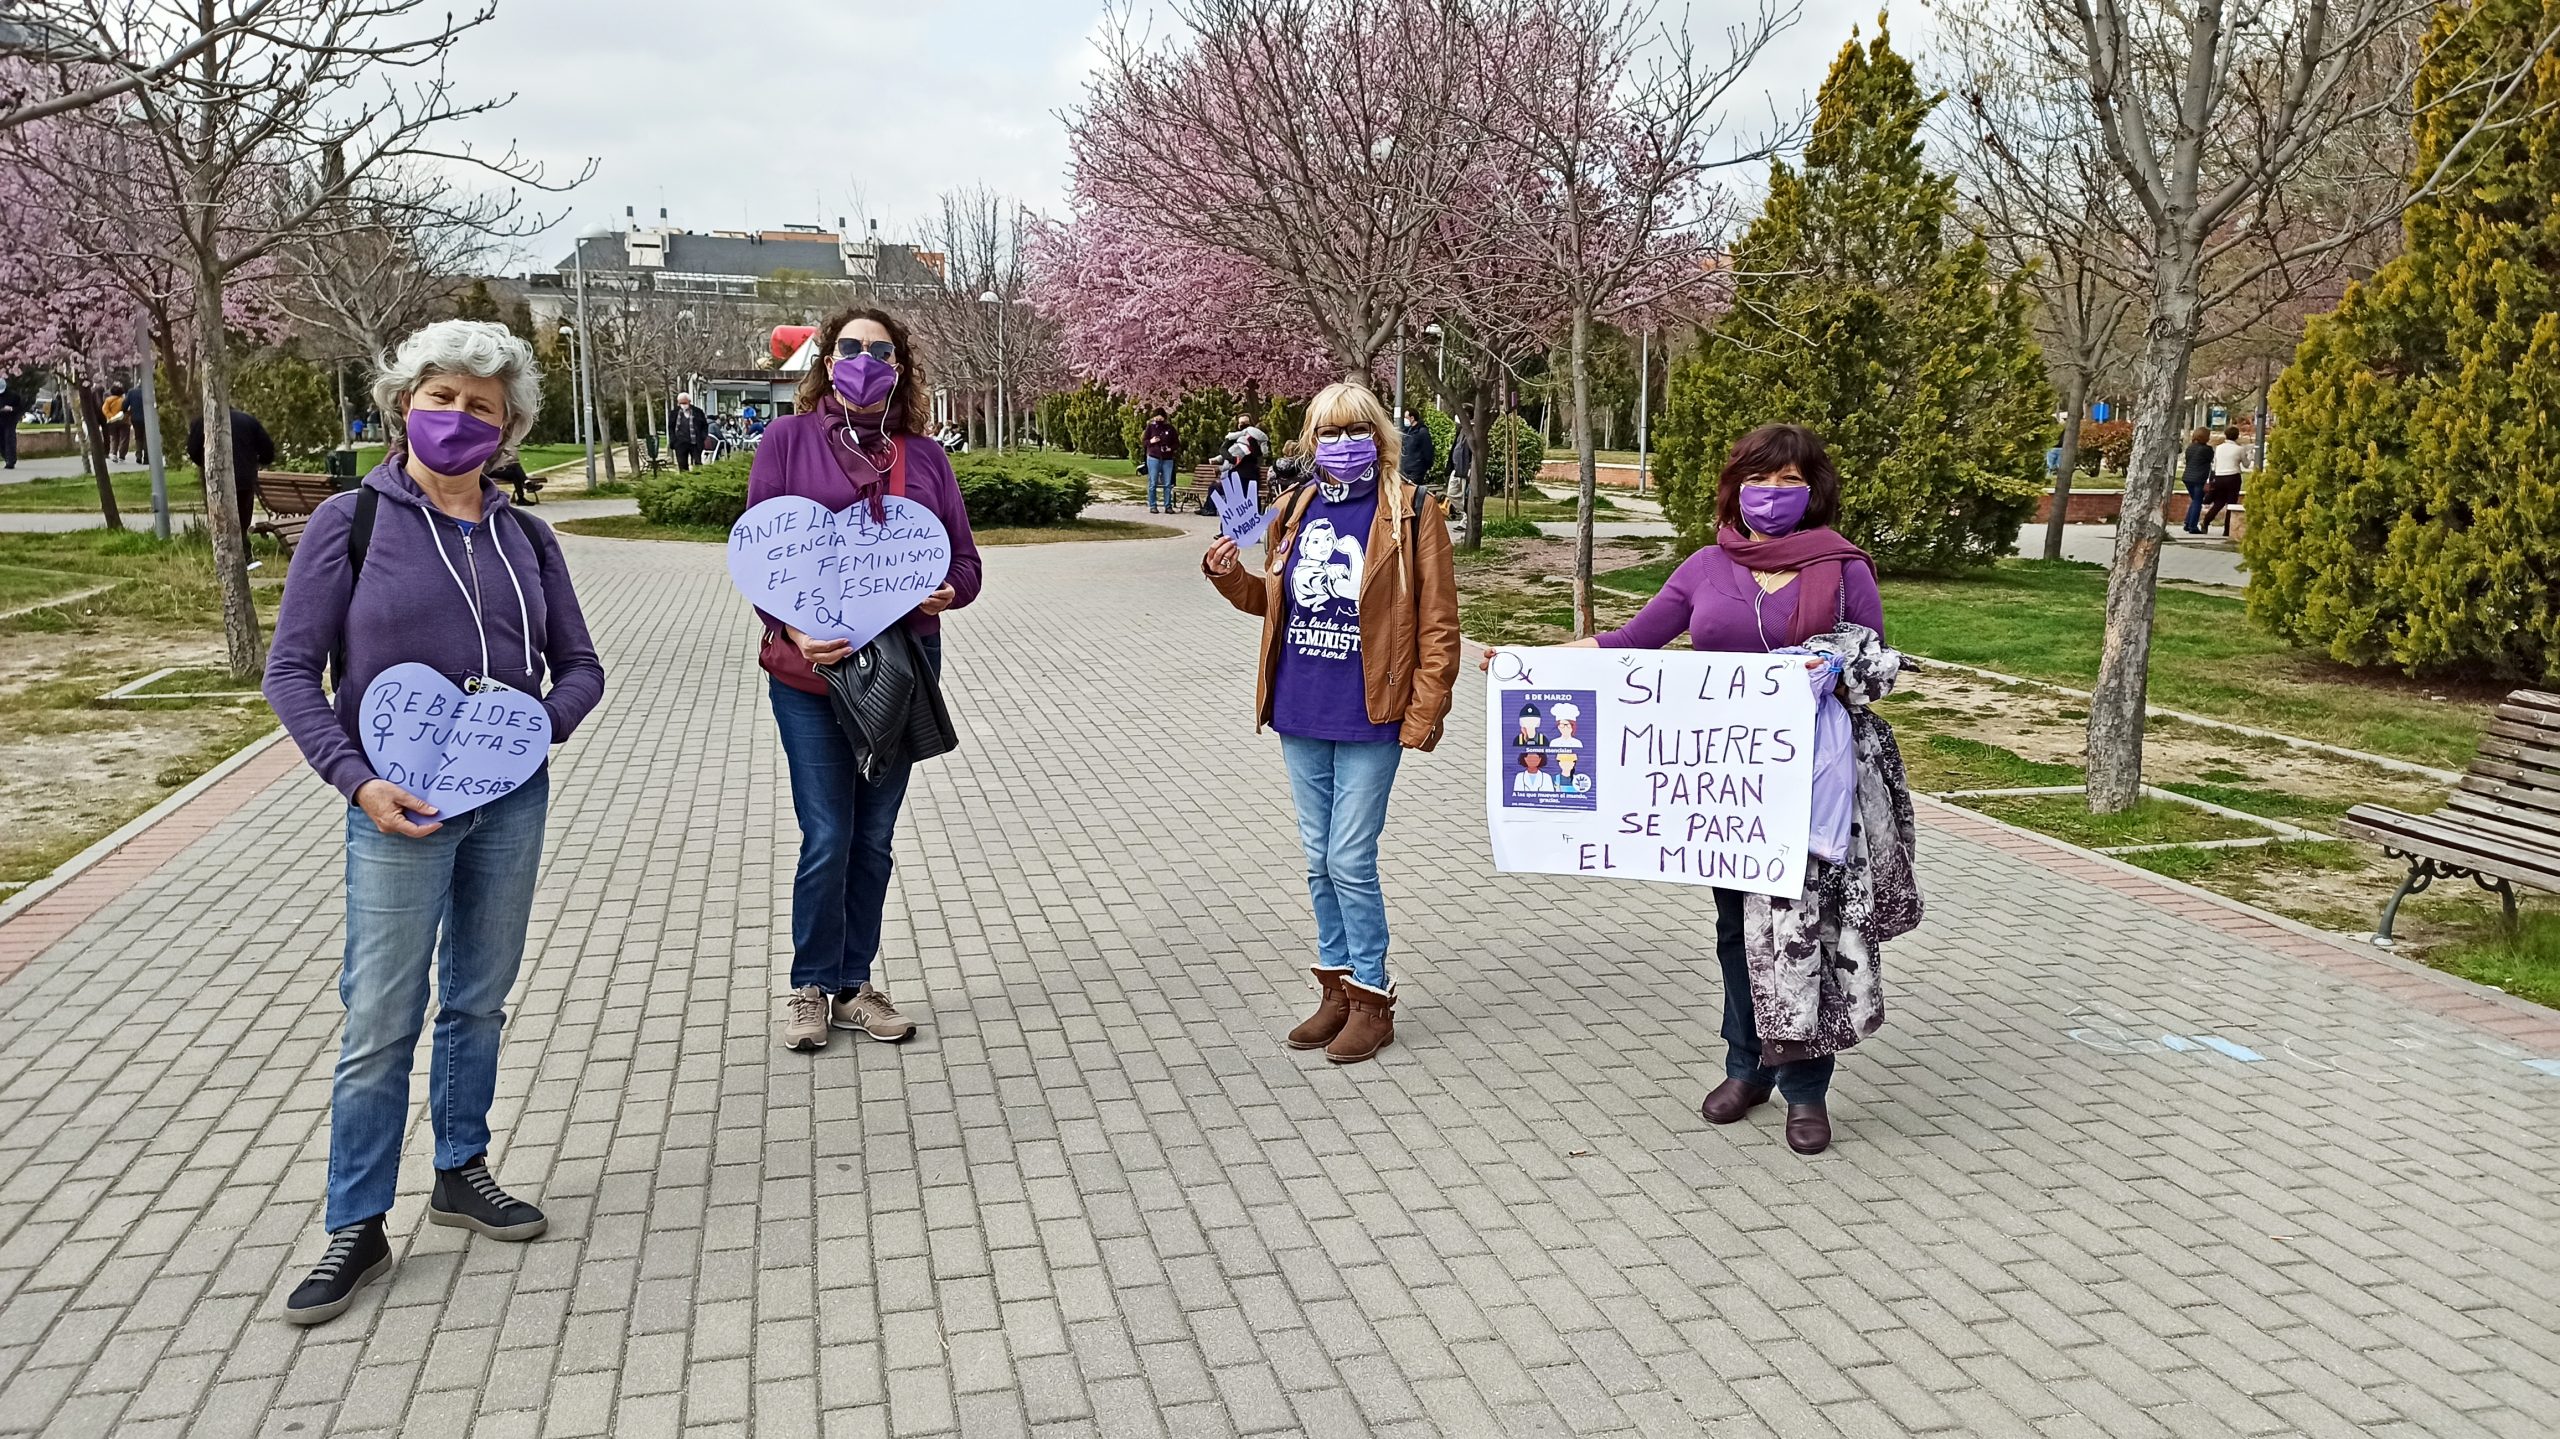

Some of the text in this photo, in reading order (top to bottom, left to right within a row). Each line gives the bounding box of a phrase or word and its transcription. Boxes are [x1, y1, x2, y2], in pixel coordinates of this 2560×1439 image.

[806, 506, 835, 533] LA
[1222, 498, 1254, 526] NI UNA
[1232, 512, 1261, 540] MENOS
[767, 526, 941, 561] GENCIA SOCIAL
[768, 547, 945, 591] EL FEMINISMO
[794, 571, 938, 612] ES ESENCIAL
[1290, 614, 1307, 628] La
[1308, 616, 1340, 631] lucha
[1287, 627, 1361, 652] FEMINIST
[1298, 646, 1348, 660] o no será
[373, 681, 544, 732] REBELDES
[409, 722, 531, 756] JUNTAS
[1620, 723, 1797, 767] MUJERES
[440, 752, 458, 771] Y
[385, 762, 516, 796] DIVERSAS
[1645, 771, 1764, 807] PARAN
[1618, 812, 1767, 844] SE PARA
